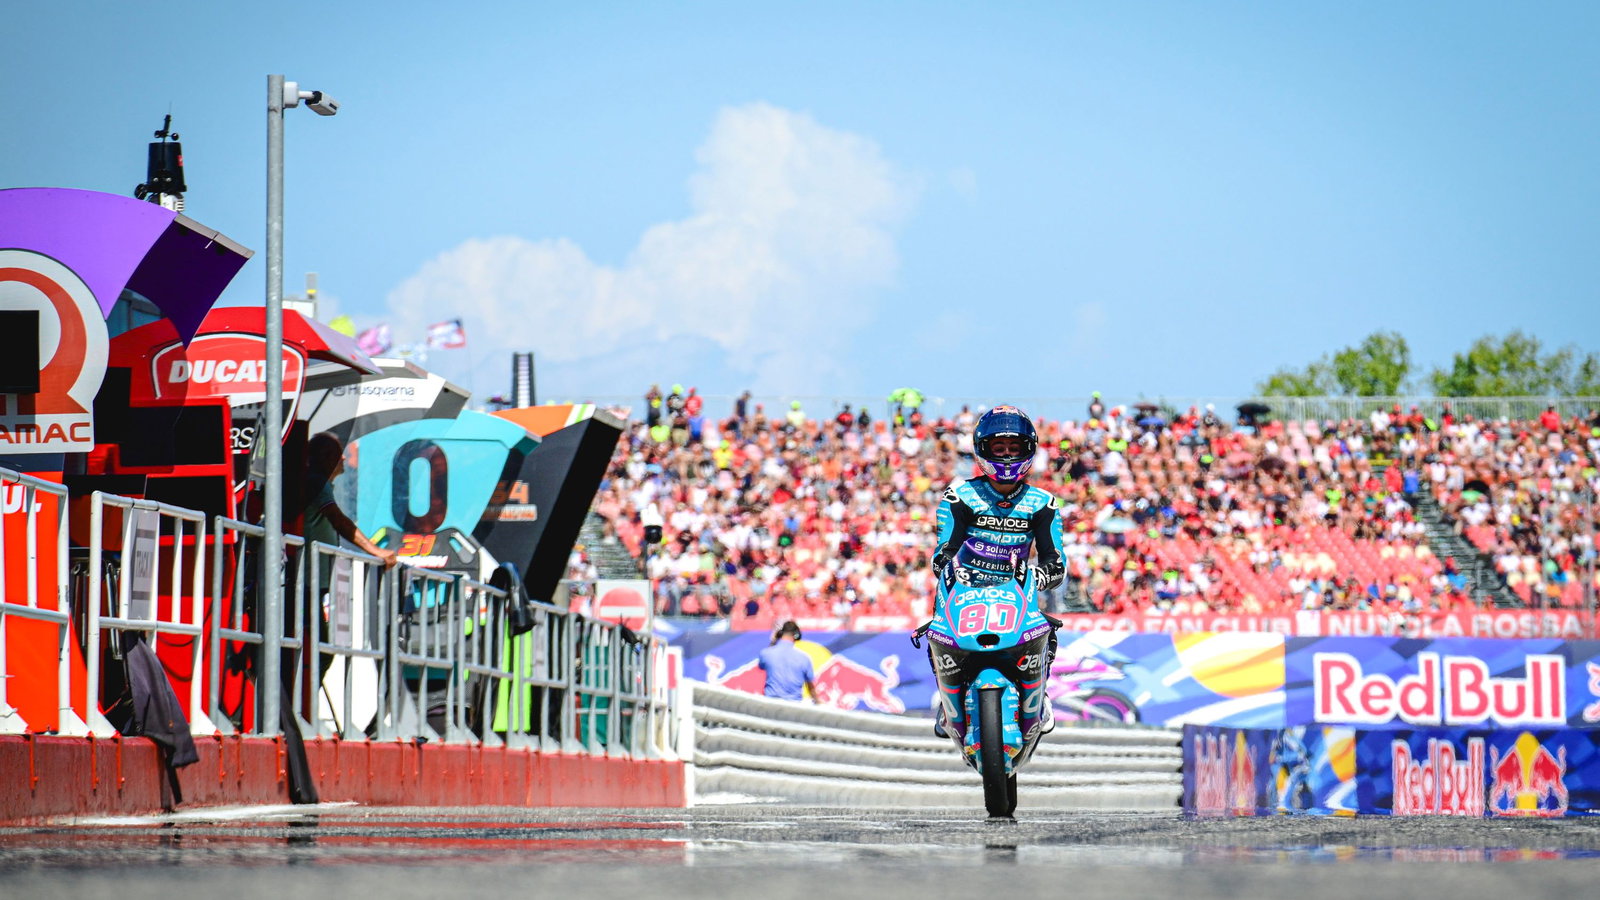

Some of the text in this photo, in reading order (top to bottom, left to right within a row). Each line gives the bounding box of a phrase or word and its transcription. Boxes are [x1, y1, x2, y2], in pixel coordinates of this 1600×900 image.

[348, 384, 415, 397] Husqvarna
[976, 516, 1029, 529] gaviota
[397, 534, 437, 556] 31
[970, 558, 1011, 572] ASTERIUS
[954, 588, 1017, 607] gaviota
[957, 602, 1019, 636] 80
[1144, 617, 1205, 633] FAN
[1210, 616, 1292, 634] CLUB
[1328, 613, 1584, 637] NUVOLA ROSSA
[1313, 652, 1566, 725] Red Bull
[1391, 737, 1485, 816] Red Bull
